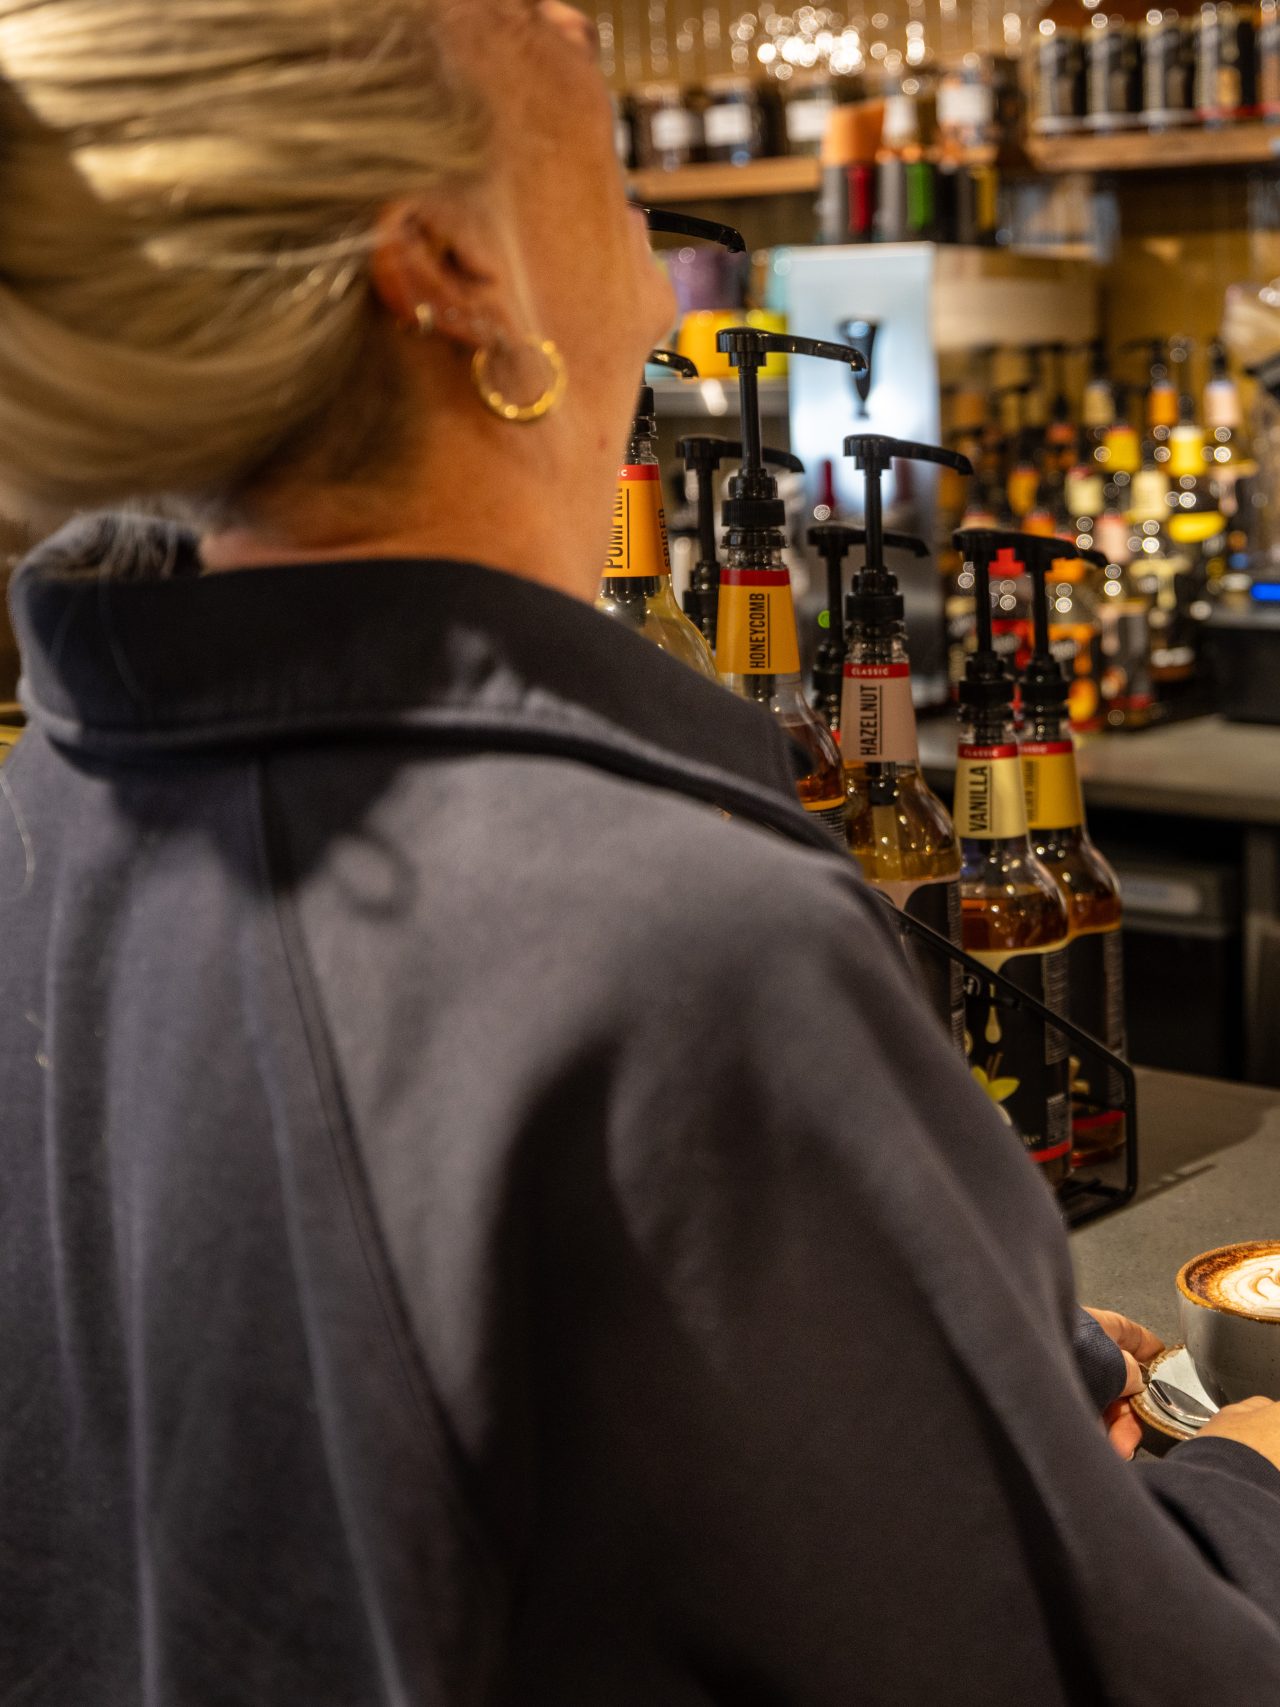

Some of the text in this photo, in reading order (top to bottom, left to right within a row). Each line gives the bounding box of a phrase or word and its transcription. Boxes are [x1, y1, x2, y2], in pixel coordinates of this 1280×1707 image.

[749, 592, 766, 669] HONEYCOMB
[850, 667, 889, 676] CLASSIC
[860, 684, 878, 756] HAZELNUT
[968, 765, 988, 832] VANILLA
